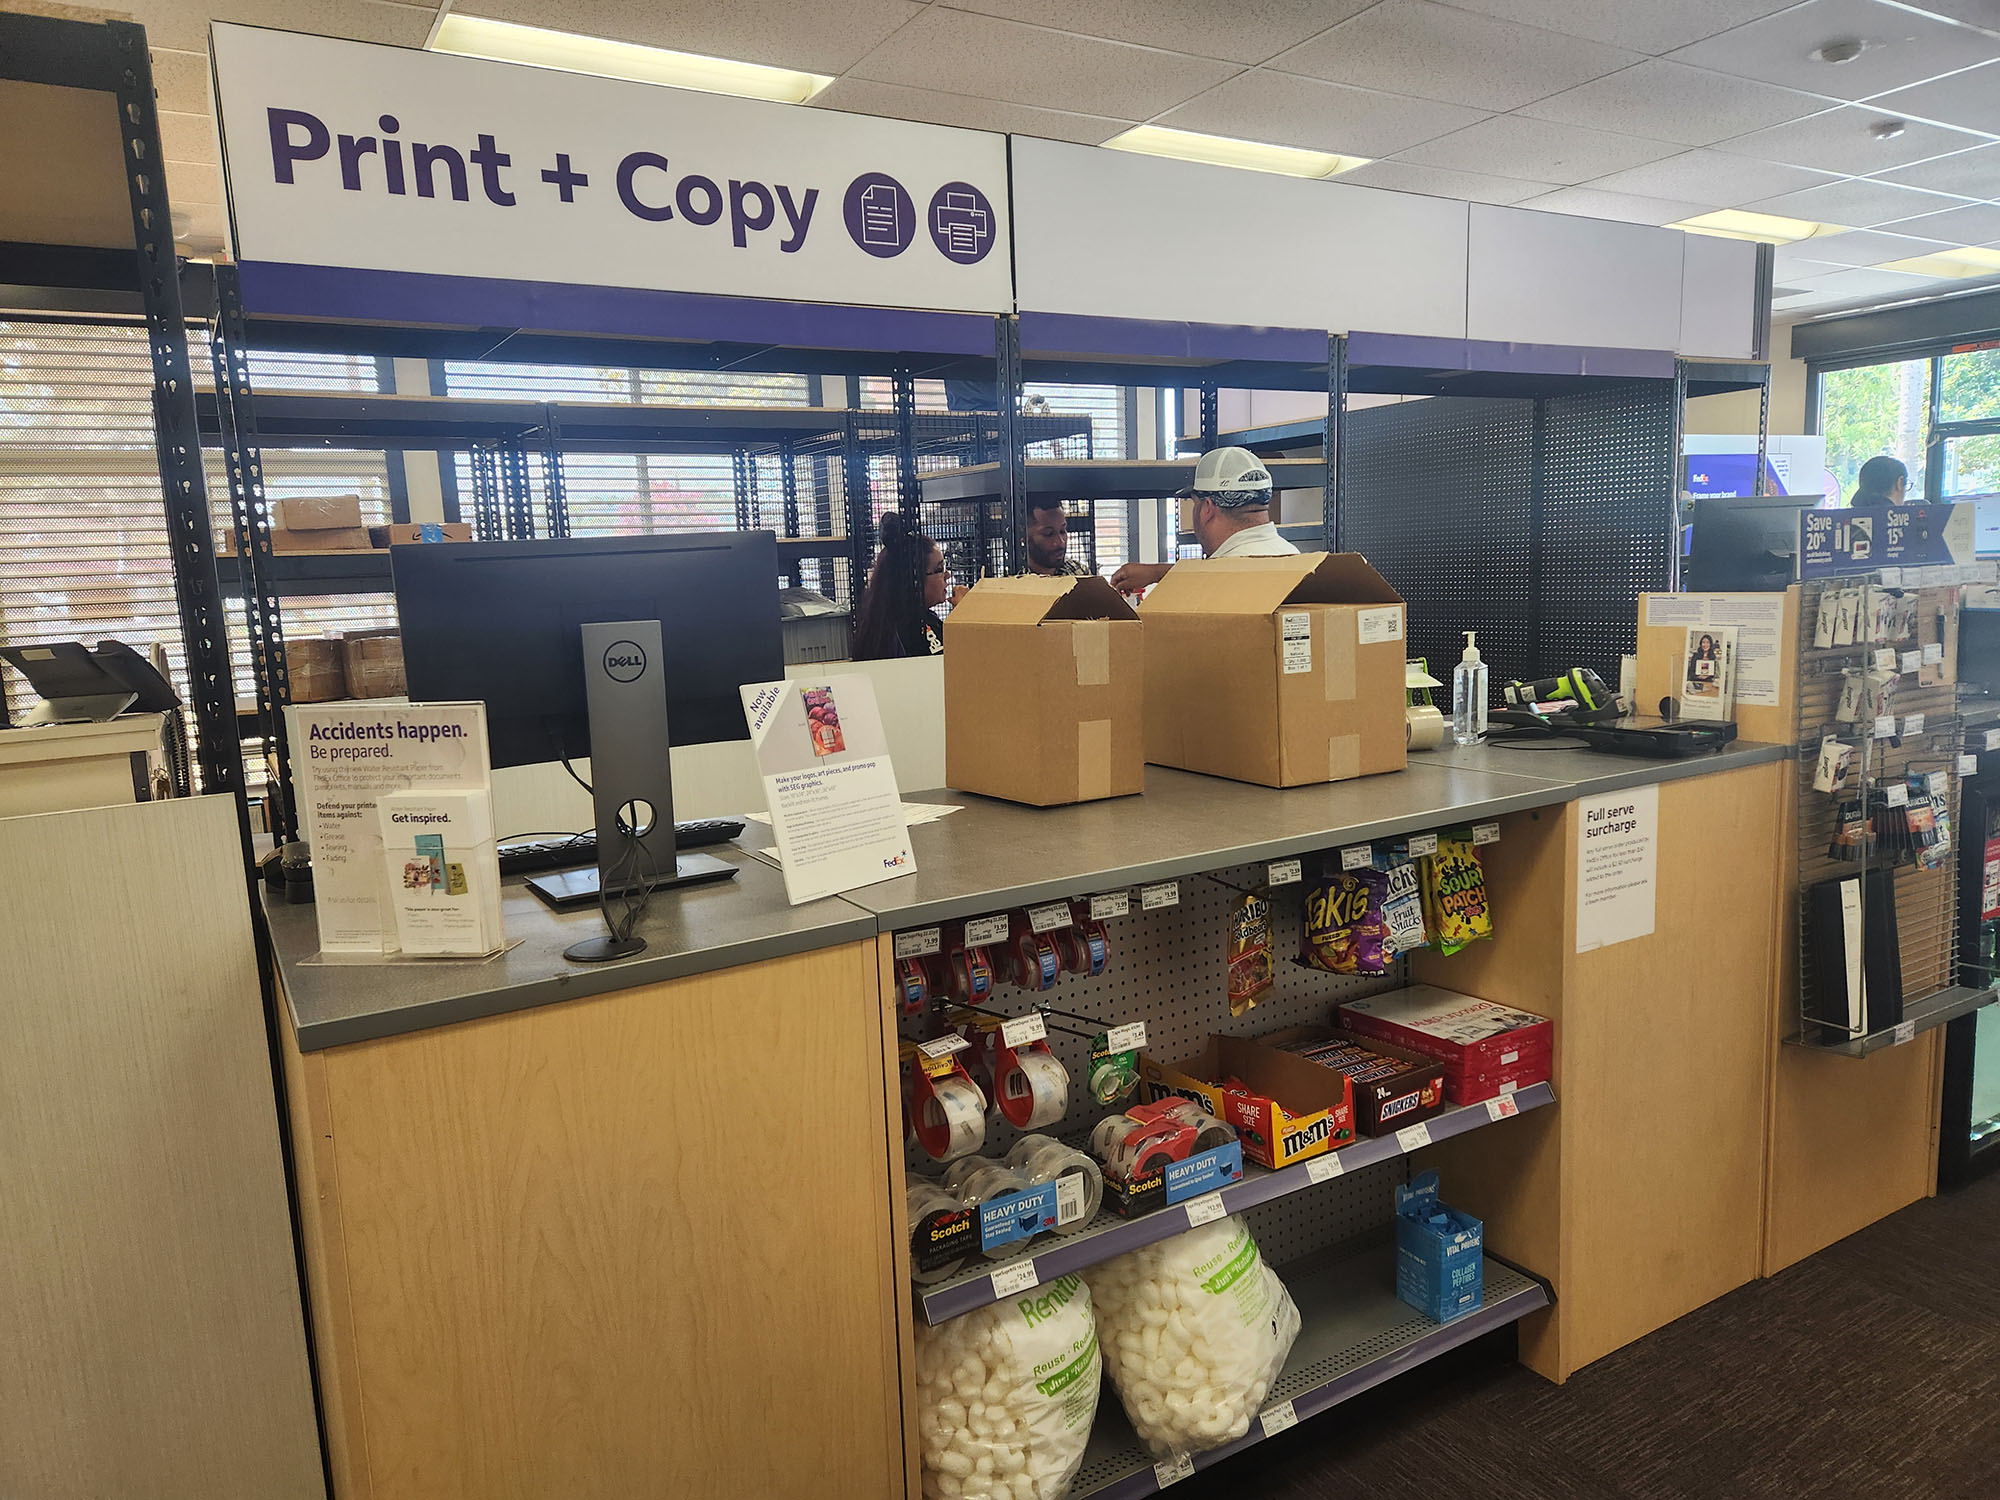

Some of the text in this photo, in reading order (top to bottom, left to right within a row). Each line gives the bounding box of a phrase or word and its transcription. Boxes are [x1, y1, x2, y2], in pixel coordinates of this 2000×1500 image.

[267, 107, 820, 253] Print + Copy
[1806, 513, 1832, 532] Save
[1887, 509, 1910, 527] Save
[1806, 532, 1826, 551] 20%
[1887, 527, 1904, 545] 15%
[608, 655, 642, 668] DELL
[749, 689, 767, 713] Now
[753, 686, 781, 731] available
[309, 721, 468, 743] Accidents happen.
[310, 743, 393, 762] Be prepared.
[775, 777, 790, 785] Make
[790, 775, 802, 785] your
[801, 772, 818, 783] logos,
[817, 769, 826, 777] art
[826, 767, 843, 778] pieces,
[851, 763, 867, 772] promo
[866, 761, 877, 769] pop
[777, 786, 790, 794] with
[790, 783, 801, 792] SEG
[801, 780, 823, 791] graphics.
[316, 801, 377, 811] Defend your printe
[1587, 804, 1635, 823] Full serve
[317, 811, 363, 820] items against:
[391, 812, 452, 825] Get inspired.
[323, 822, 341, 830] Water
[1586, 818, 1637, 839] surcharge
[324, 833, 345, 841] Grease
[326, 854, 347, 863] Fading
[883, 856, 905, 869] FedEx
[1387, 866, 1419, 896] lch's
[1440, 869, 1482, 895] SOUR
[1441, 886, 1488, 918] PATCH
[1303, 885, 1370, 938] Takis
[1393, 905, 1415, 922] Fruit
[1390, 916, 1422, 935] Snacks
[1321, 931, 1341, 942] FUEGO
[1092, 1048, 1111, 1060] Scot
[1324, 1054, 1361, 1068] NICKERS
[1376, 1086, 1386, 1100] 24
[1237, 1102, 1260, 1119] SHARE
[1335, 1105, 1349, 1117] SHARE
[1383, 1092, 1419, 1120] SNICKERS
[1243, 1114, 1256, 1127] SIZE
[1337, 1115, 1347, 1124] SIZE
[1168, 1155, 1217, 1182] HEAVY DUTY
[1103, 1175, 1123, 1192] Scotch
[1129, 1175, 1162, 1196] Scotch
[983, 1194, 1045, 1223] HEAVY DUTY
[930, 1218, 971, 1242] Scotch
[984, 1220, 1012, 1233] Guaranteed
[1042, 1215, 1056, 1228] 3M
[984, 1226, 1012, 1240] Stay Sealed
[929, 1233, 974, 1254] PACKAGING TAPE
[1446, 1243, 1461, 1258] VITAL
[1192, 1253, 1223, 1278] Reuse
[1451, 1262, 1476, 1280] COLLAGEN
[1016, 1269, 1035, 1281] $24.99
[1215, 1270, 1233, 1290] Just
[1452, 1271, 1476, 1289] PEPTIDES
[1033, 1352, 1066, 1378] Reuse
[1049, 1371, 1070, 1392] Just
